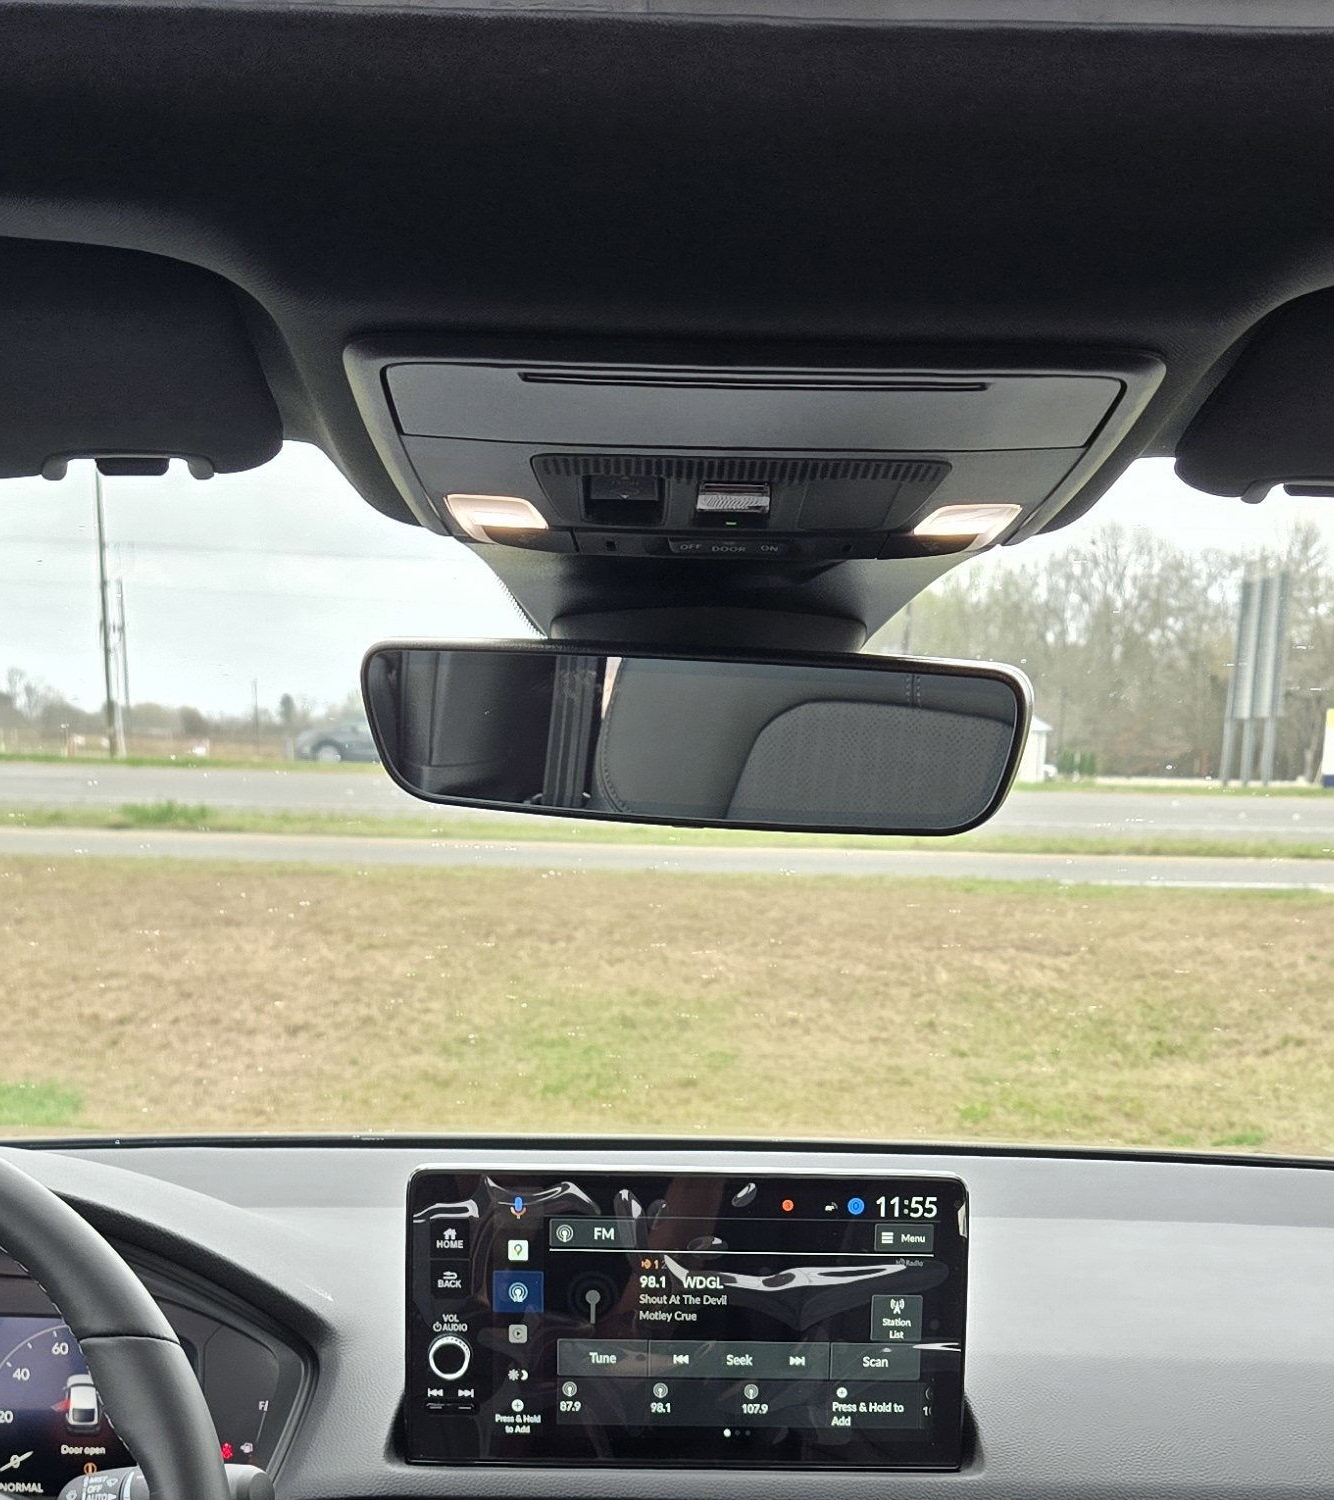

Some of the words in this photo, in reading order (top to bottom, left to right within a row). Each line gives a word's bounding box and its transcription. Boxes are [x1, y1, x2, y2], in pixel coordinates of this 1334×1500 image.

[875, 1196, 938, 1218] 11:55
[593, 1227, 615, 1240] FM
[901, 1234, 926, 1243] Menu
[436, 1240, 463, 1249] HOME
[437, 1279, 462, 1288] BACK
[639, 1275, 666, 1289] 98.1
[682, 1276, 724, 1289] WDGL
[639, 1293, 669, 1305] Shout
[669, 1295, 681, 1305] At
[683, 1295, 701, 1305] The
[702, 1294, 728, 1306] Devil
[442, 1313, 459, 1323] VOL
[639, 1310, 672, 1322] Motley
[674, 1311, 698, 1321] Crue
[442, 1323, 468, 1332] AUDIO
[882, 1318, 912, 1327] Station
[889, 1330, 904, 1339] List
[51, 1342, 69, 1355] 60
[589, 1352, 617, 1364] Tune
[726, 1354, 753, 1366] Seek
[862, 1356, 889, 1368] Scan
[12, 1368, 31, 1381] 40
[559, 1401, 582, 1412] 87.9
[650, 1402, 671, 1413] 98.1
[741, 1403, 768, 1415] 107.9
[832, 1402, 857, 1413] Press
[859, 1402, 867, 1413] &
[869, 1402, 892, 1413] Hold
[893, 1403, 905, 1413] to
[495, 1414, 514, 1423] Press
[523, 1414, 541, 1424] Hold
[831, 1416, 852, 1427] Add
[505, 1426, 514, 1434] to
[514, 1425, 531, 1434] Add
[60, 1444, 84, 1455] Door
[83, 1446, 106, 1456] open
[0, 1482, 44, 1493] NORMAL
[87, 1484, 103, 1494] OFF
